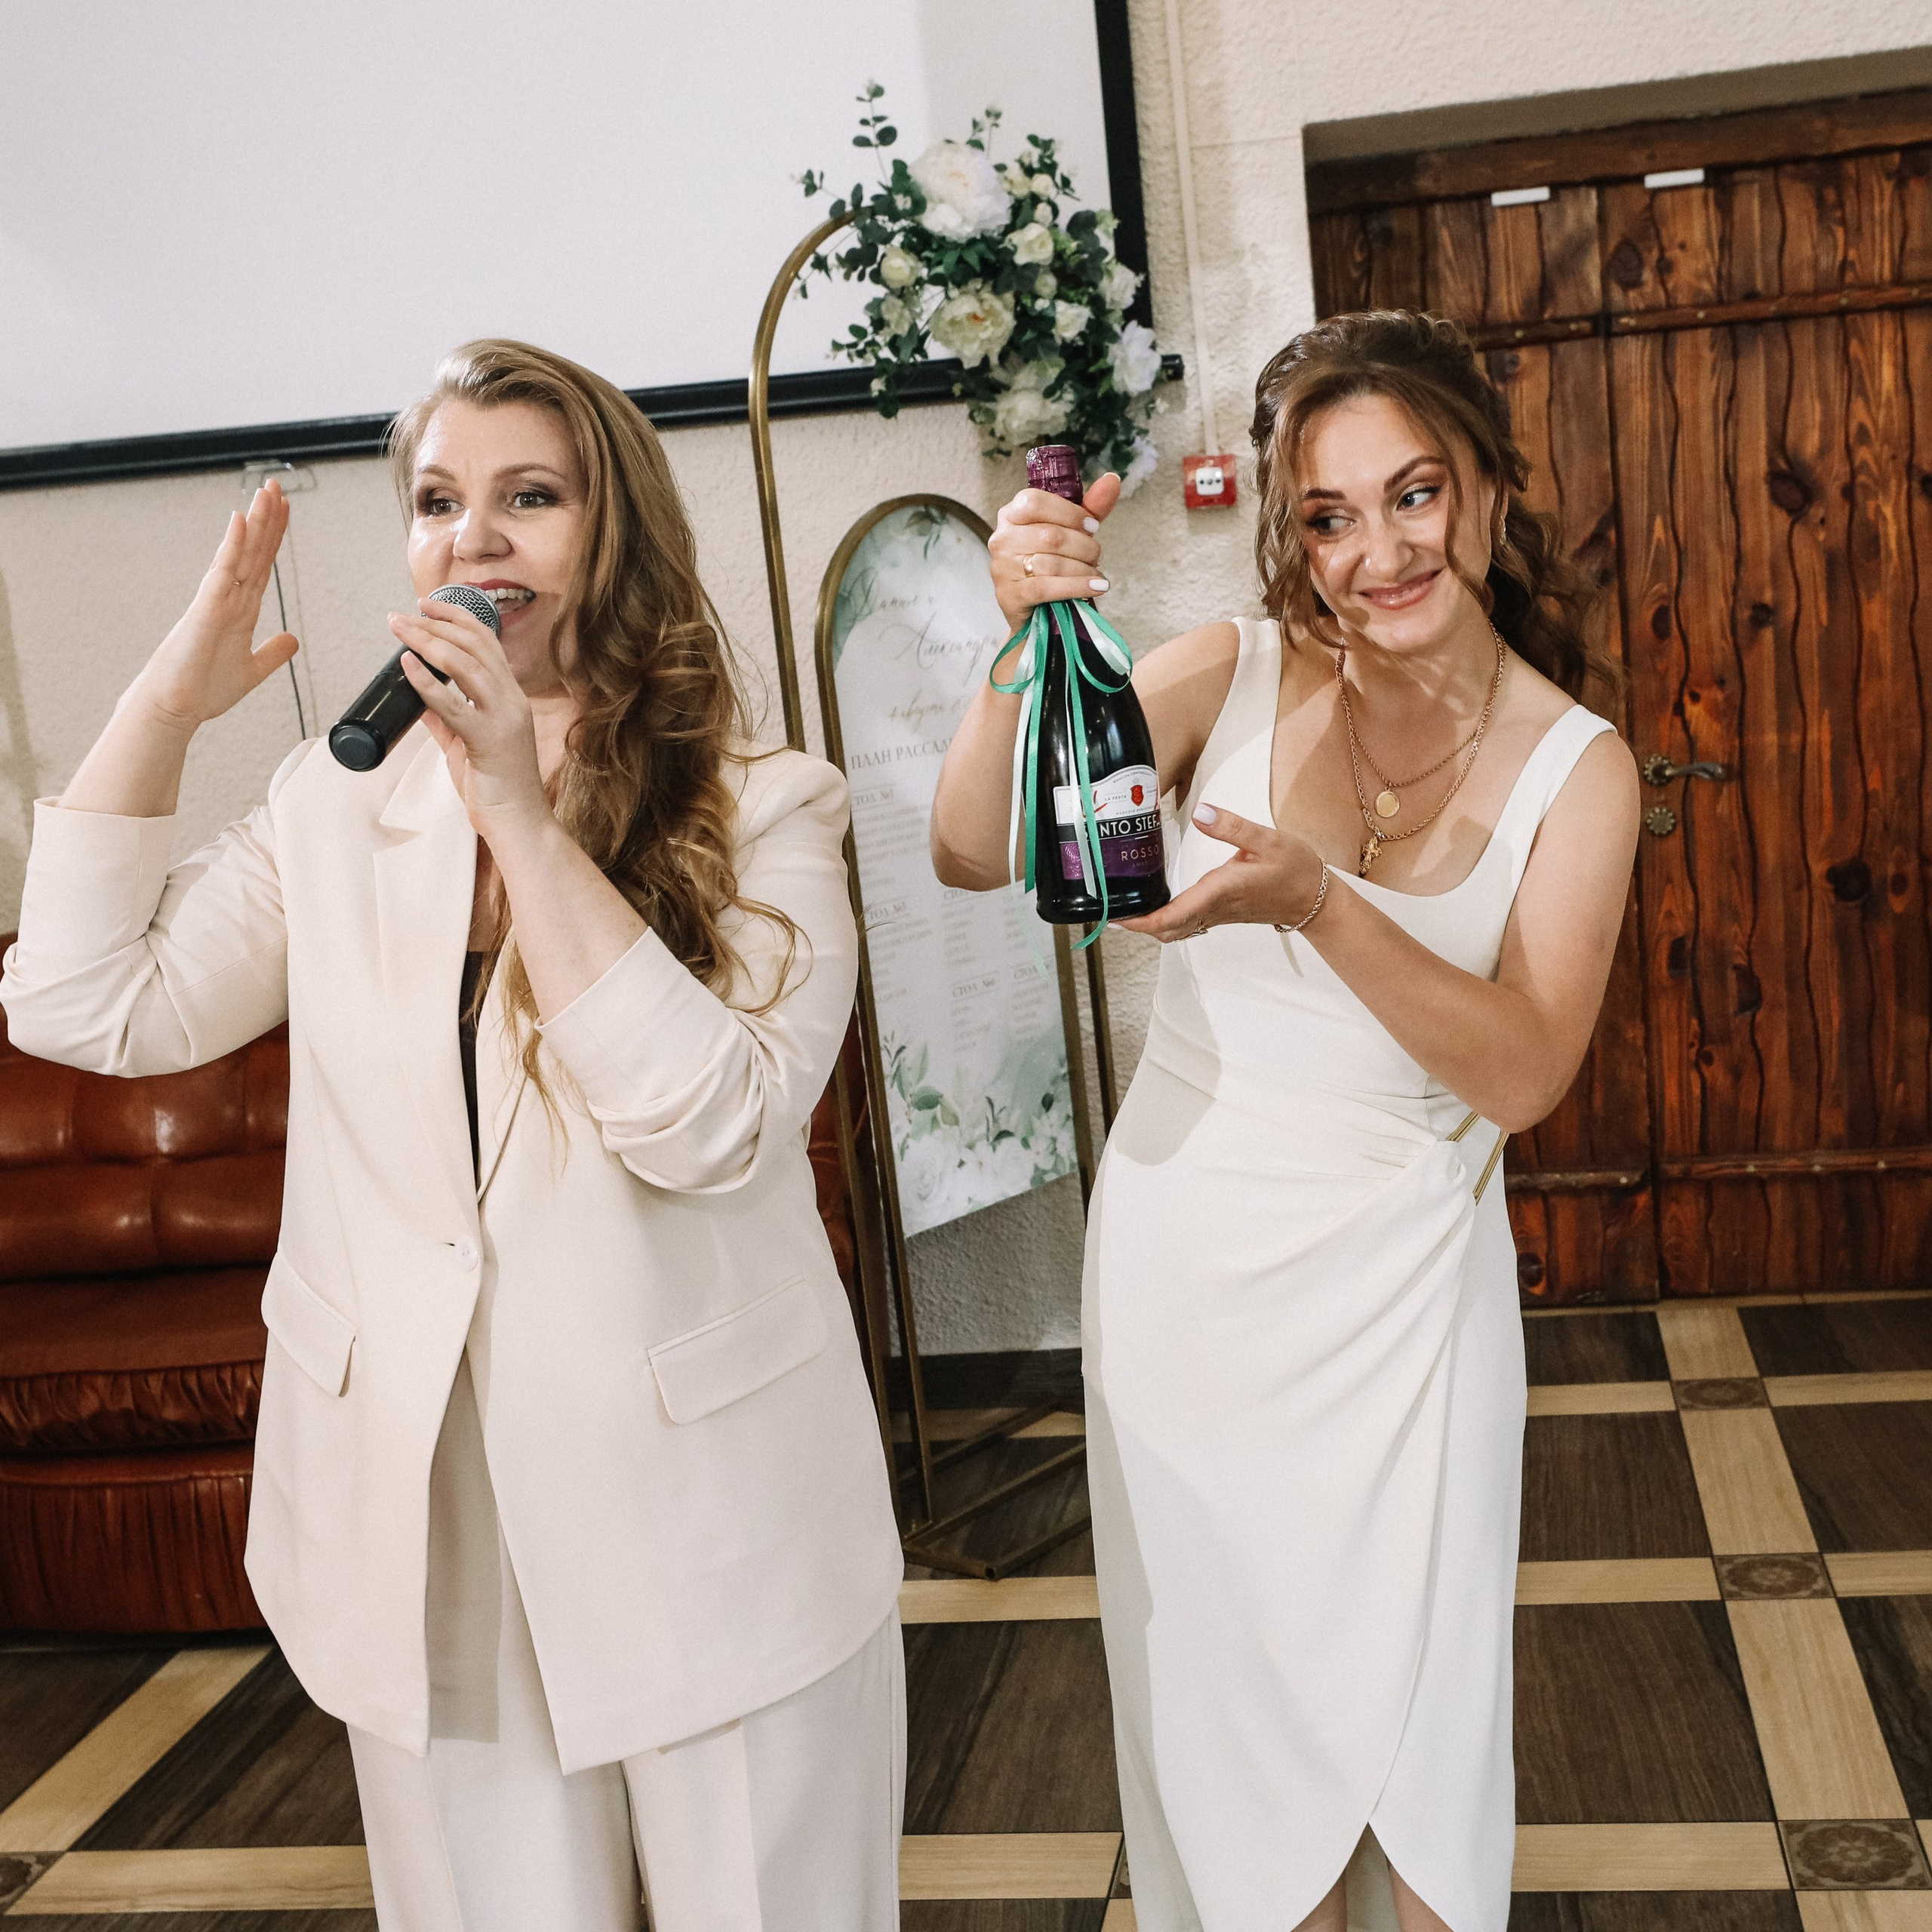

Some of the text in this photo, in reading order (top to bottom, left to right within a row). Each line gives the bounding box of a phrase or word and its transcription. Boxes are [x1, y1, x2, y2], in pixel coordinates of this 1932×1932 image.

[850, 737, 953, 770] ПЛАН РАССАД
[851, 793, 875, 806] ТОЛ
[1084, 820, 1131, 838] NTO
[1121, 844, 1159, 861] ROSSO
